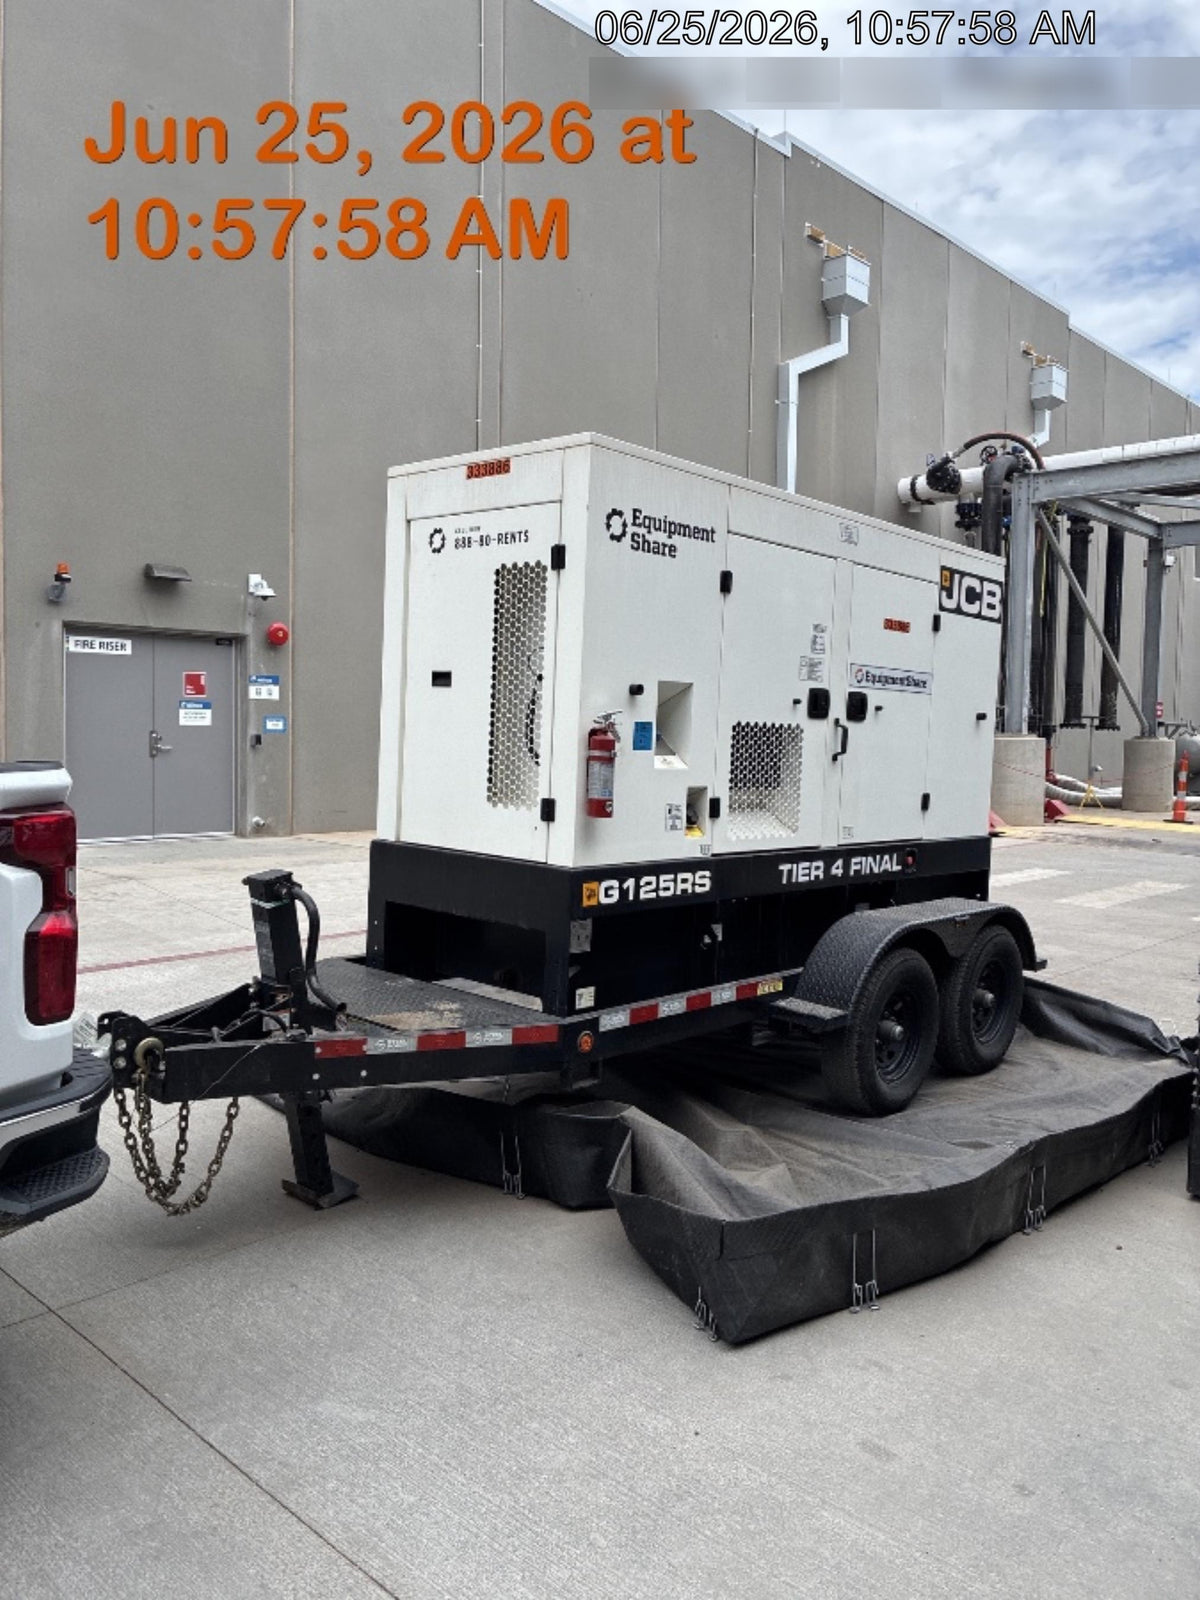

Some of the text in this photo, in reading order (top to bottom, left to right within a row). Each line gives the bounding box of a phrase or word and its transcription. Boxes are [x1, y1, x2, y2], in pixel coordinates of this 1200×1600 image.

[630, 507, 716, 543] Equipment
[630, 531, 677, 559] Share
[940, 573, 1002, 620] JCB
[74, 639, 127, 652] FIRE RISER
[778, 853, 902, 885] TIER 4 FINAL
[598, 870, 712, 904] G125RS
